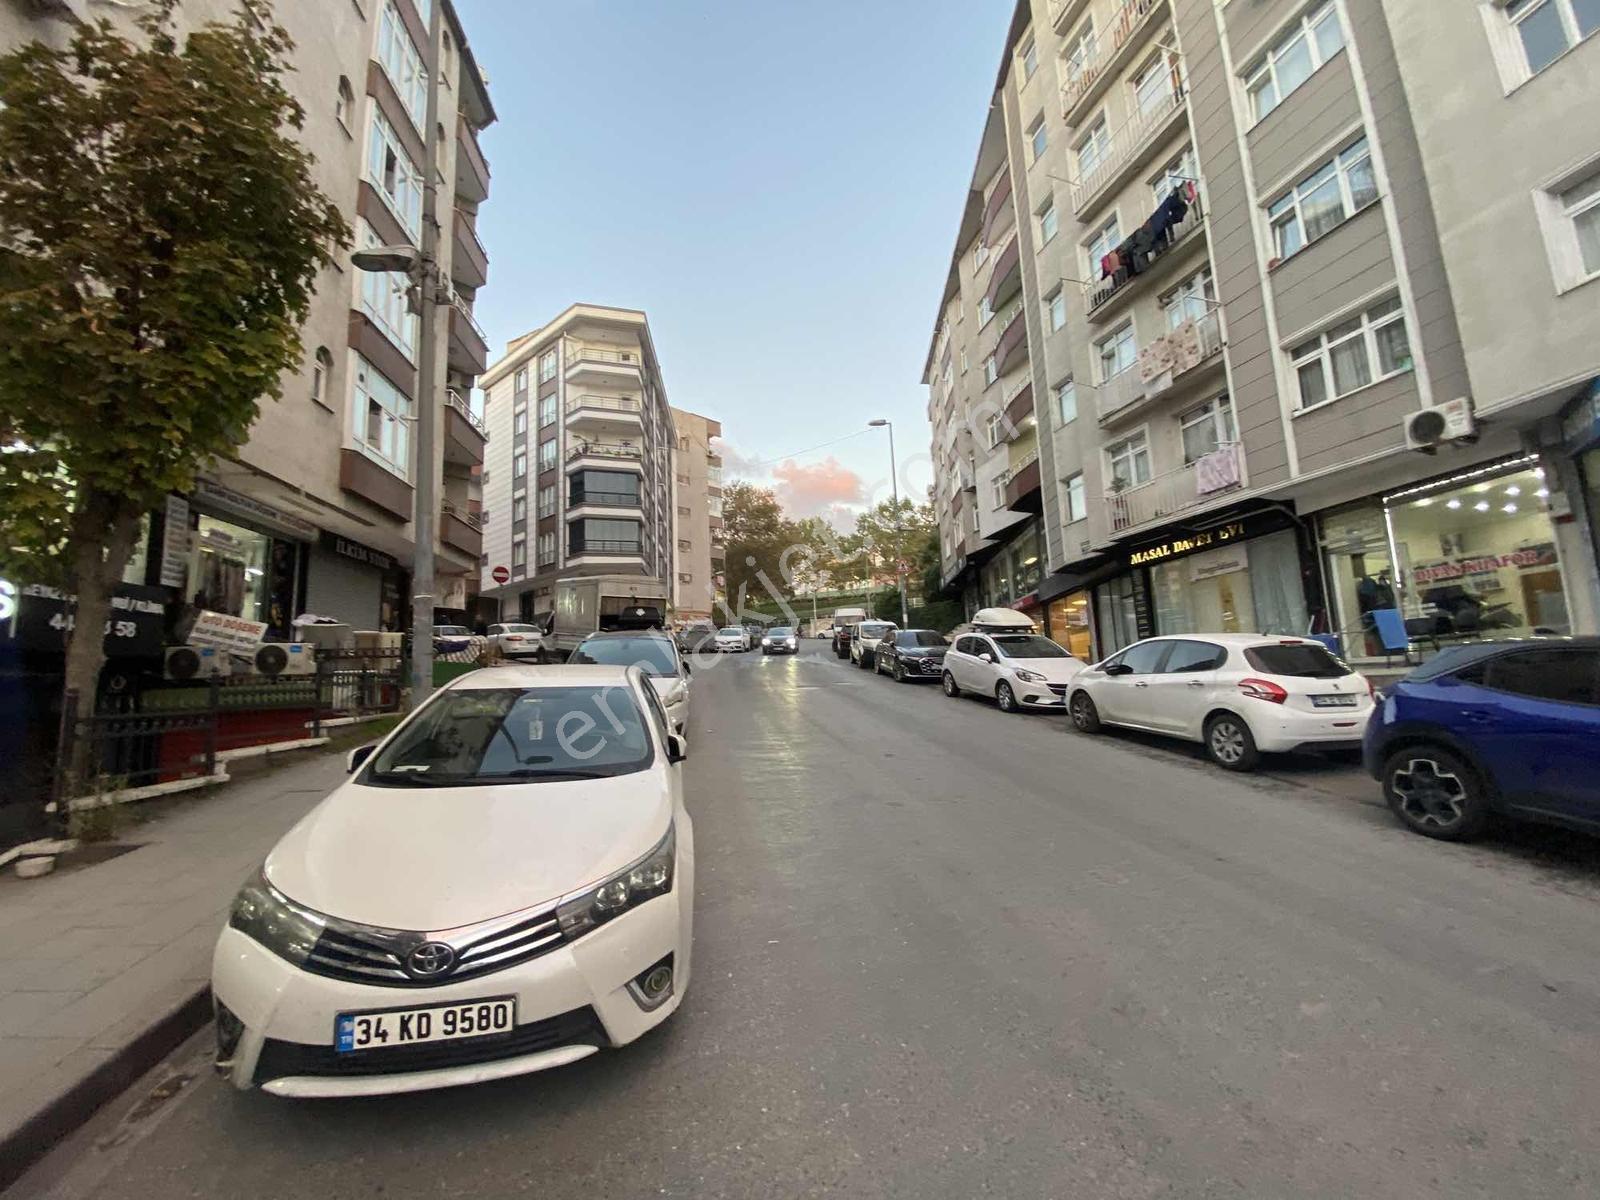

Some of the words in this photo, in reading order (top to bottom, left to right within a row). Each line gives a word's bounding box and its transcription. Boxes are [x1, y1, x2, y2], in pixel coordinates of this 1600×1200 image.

[1130, 544, 1171, 565] MASAL
[116, 620, 137, 638] 58
[356, 1018, 389, 1046] 34
[399, 1012, 432, 1042] KD
[442, 1003, 508, 1037] 9580
